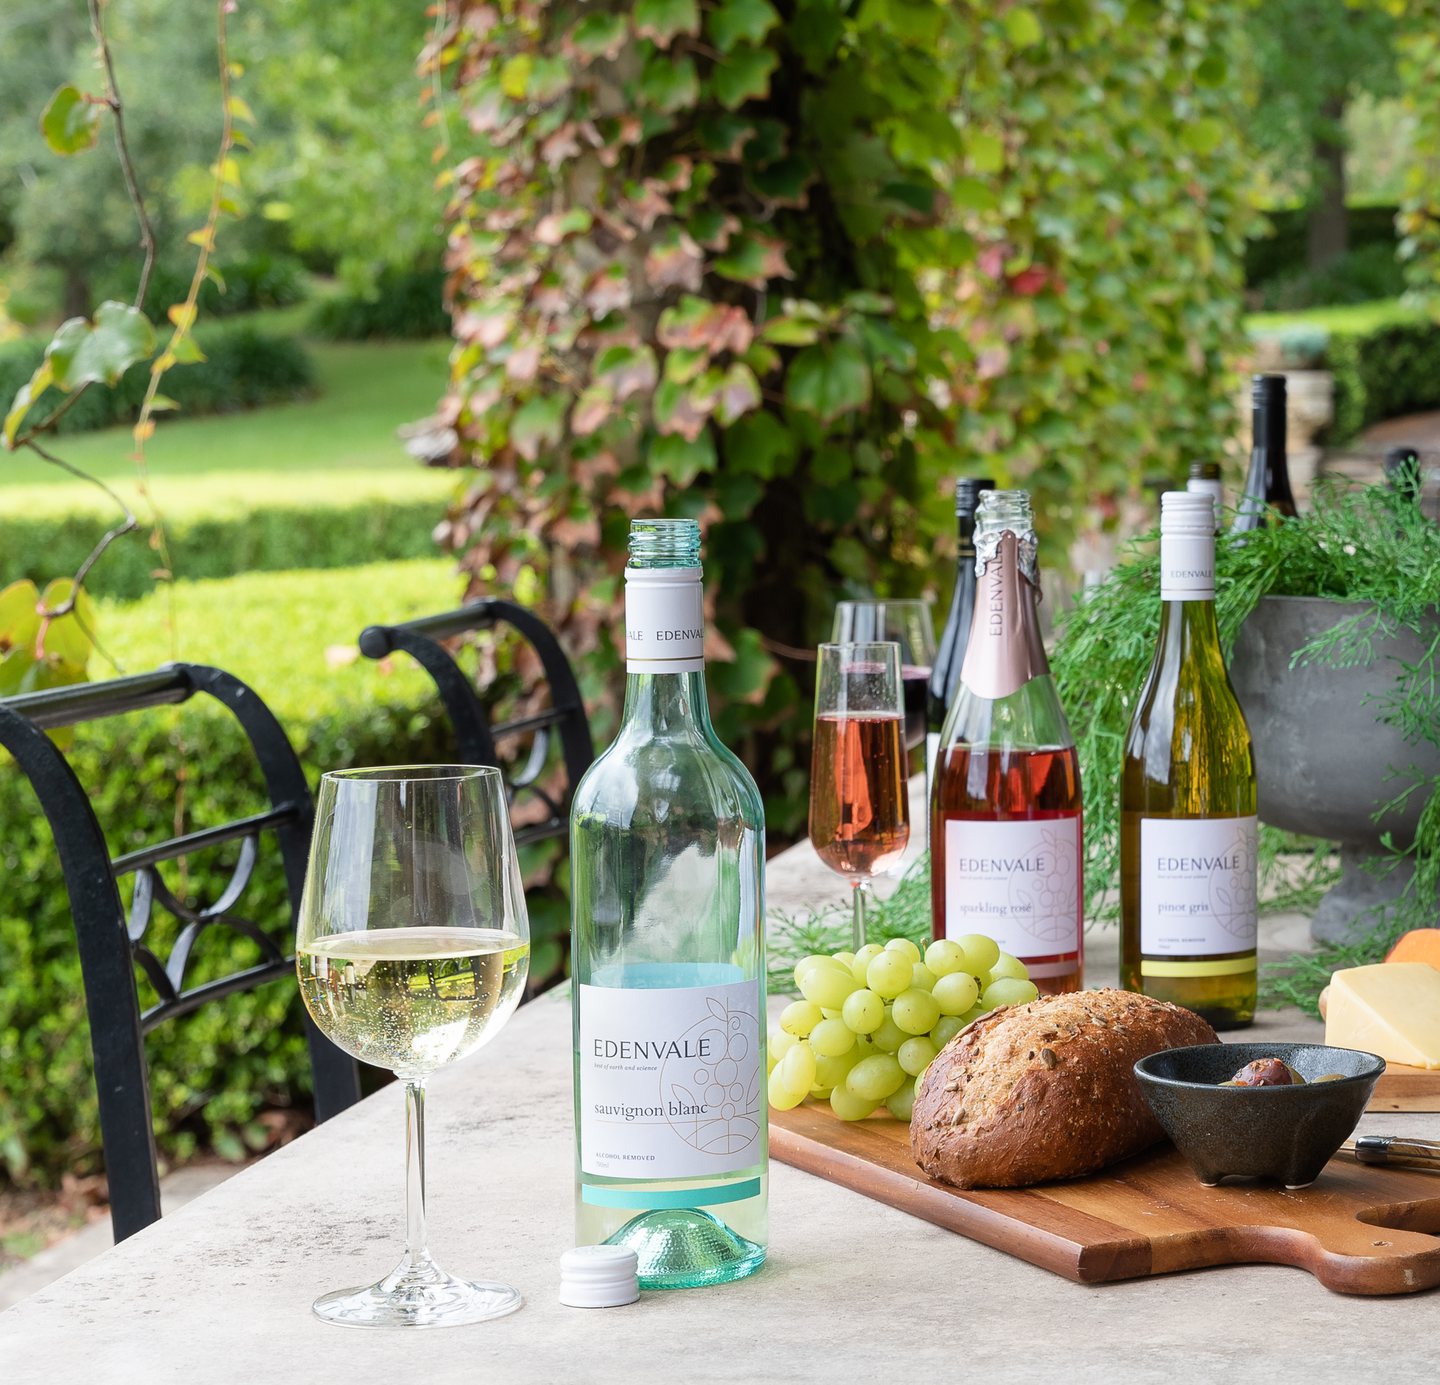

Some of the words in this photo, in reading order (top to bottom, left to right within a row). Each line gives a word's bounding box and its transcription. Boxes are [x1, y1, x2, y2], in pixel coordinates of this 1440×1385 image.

[656, 629, 704, 641] EDENVAL
[960, 857, 1045, 872] EDENVALE
[1157, 855, 1240, 872] EDENVALE
[960, 902, 1007, 917] sparkling
[1158, 902, 1185, 915] pinot
[594, 1038, 711, 1060] EDENVALE
[594, 1103, 663, 1121] sauvignon
[669, 1101, 709, 1116] blanc
